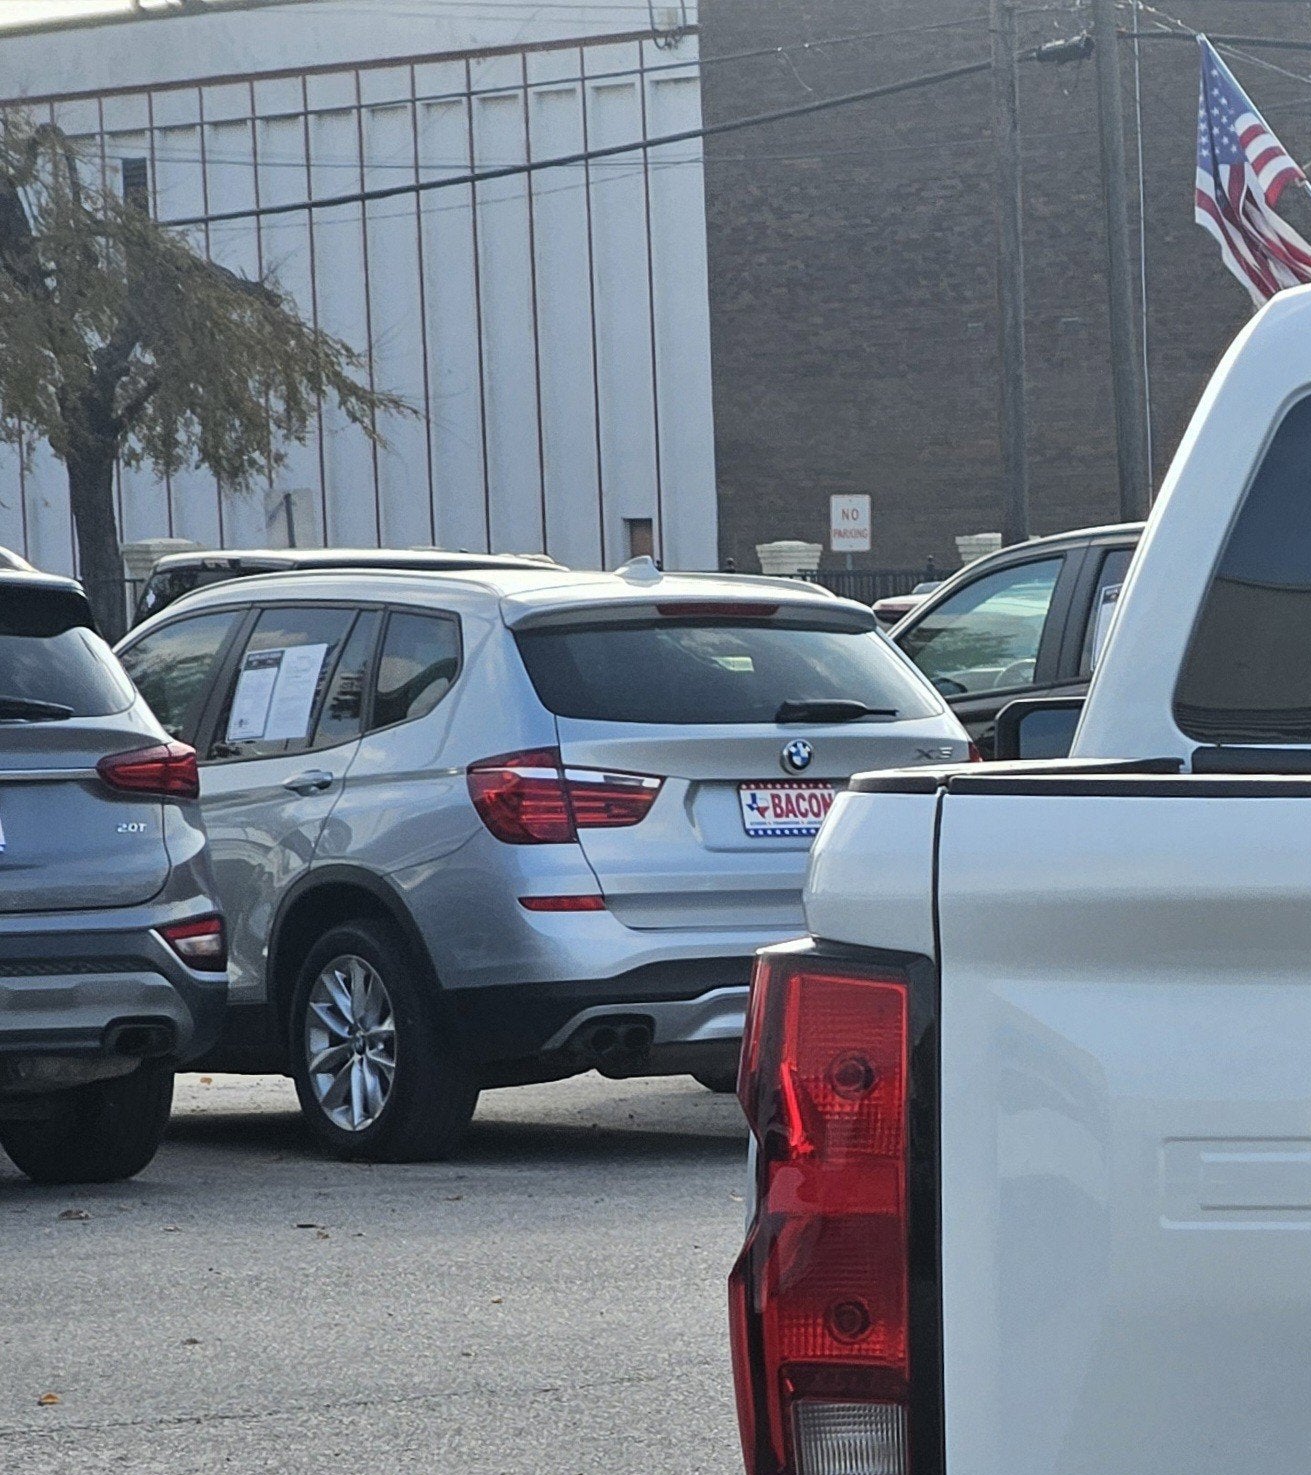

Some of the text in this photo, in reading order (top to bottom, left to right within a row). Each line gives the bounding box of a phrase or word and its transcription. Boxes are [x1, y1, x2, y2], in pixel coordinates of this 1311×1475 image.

[842, 508, 859, 521] NO
[833, 528, 868, 539] PARKING
[770, 792, 834, 819] BACON
